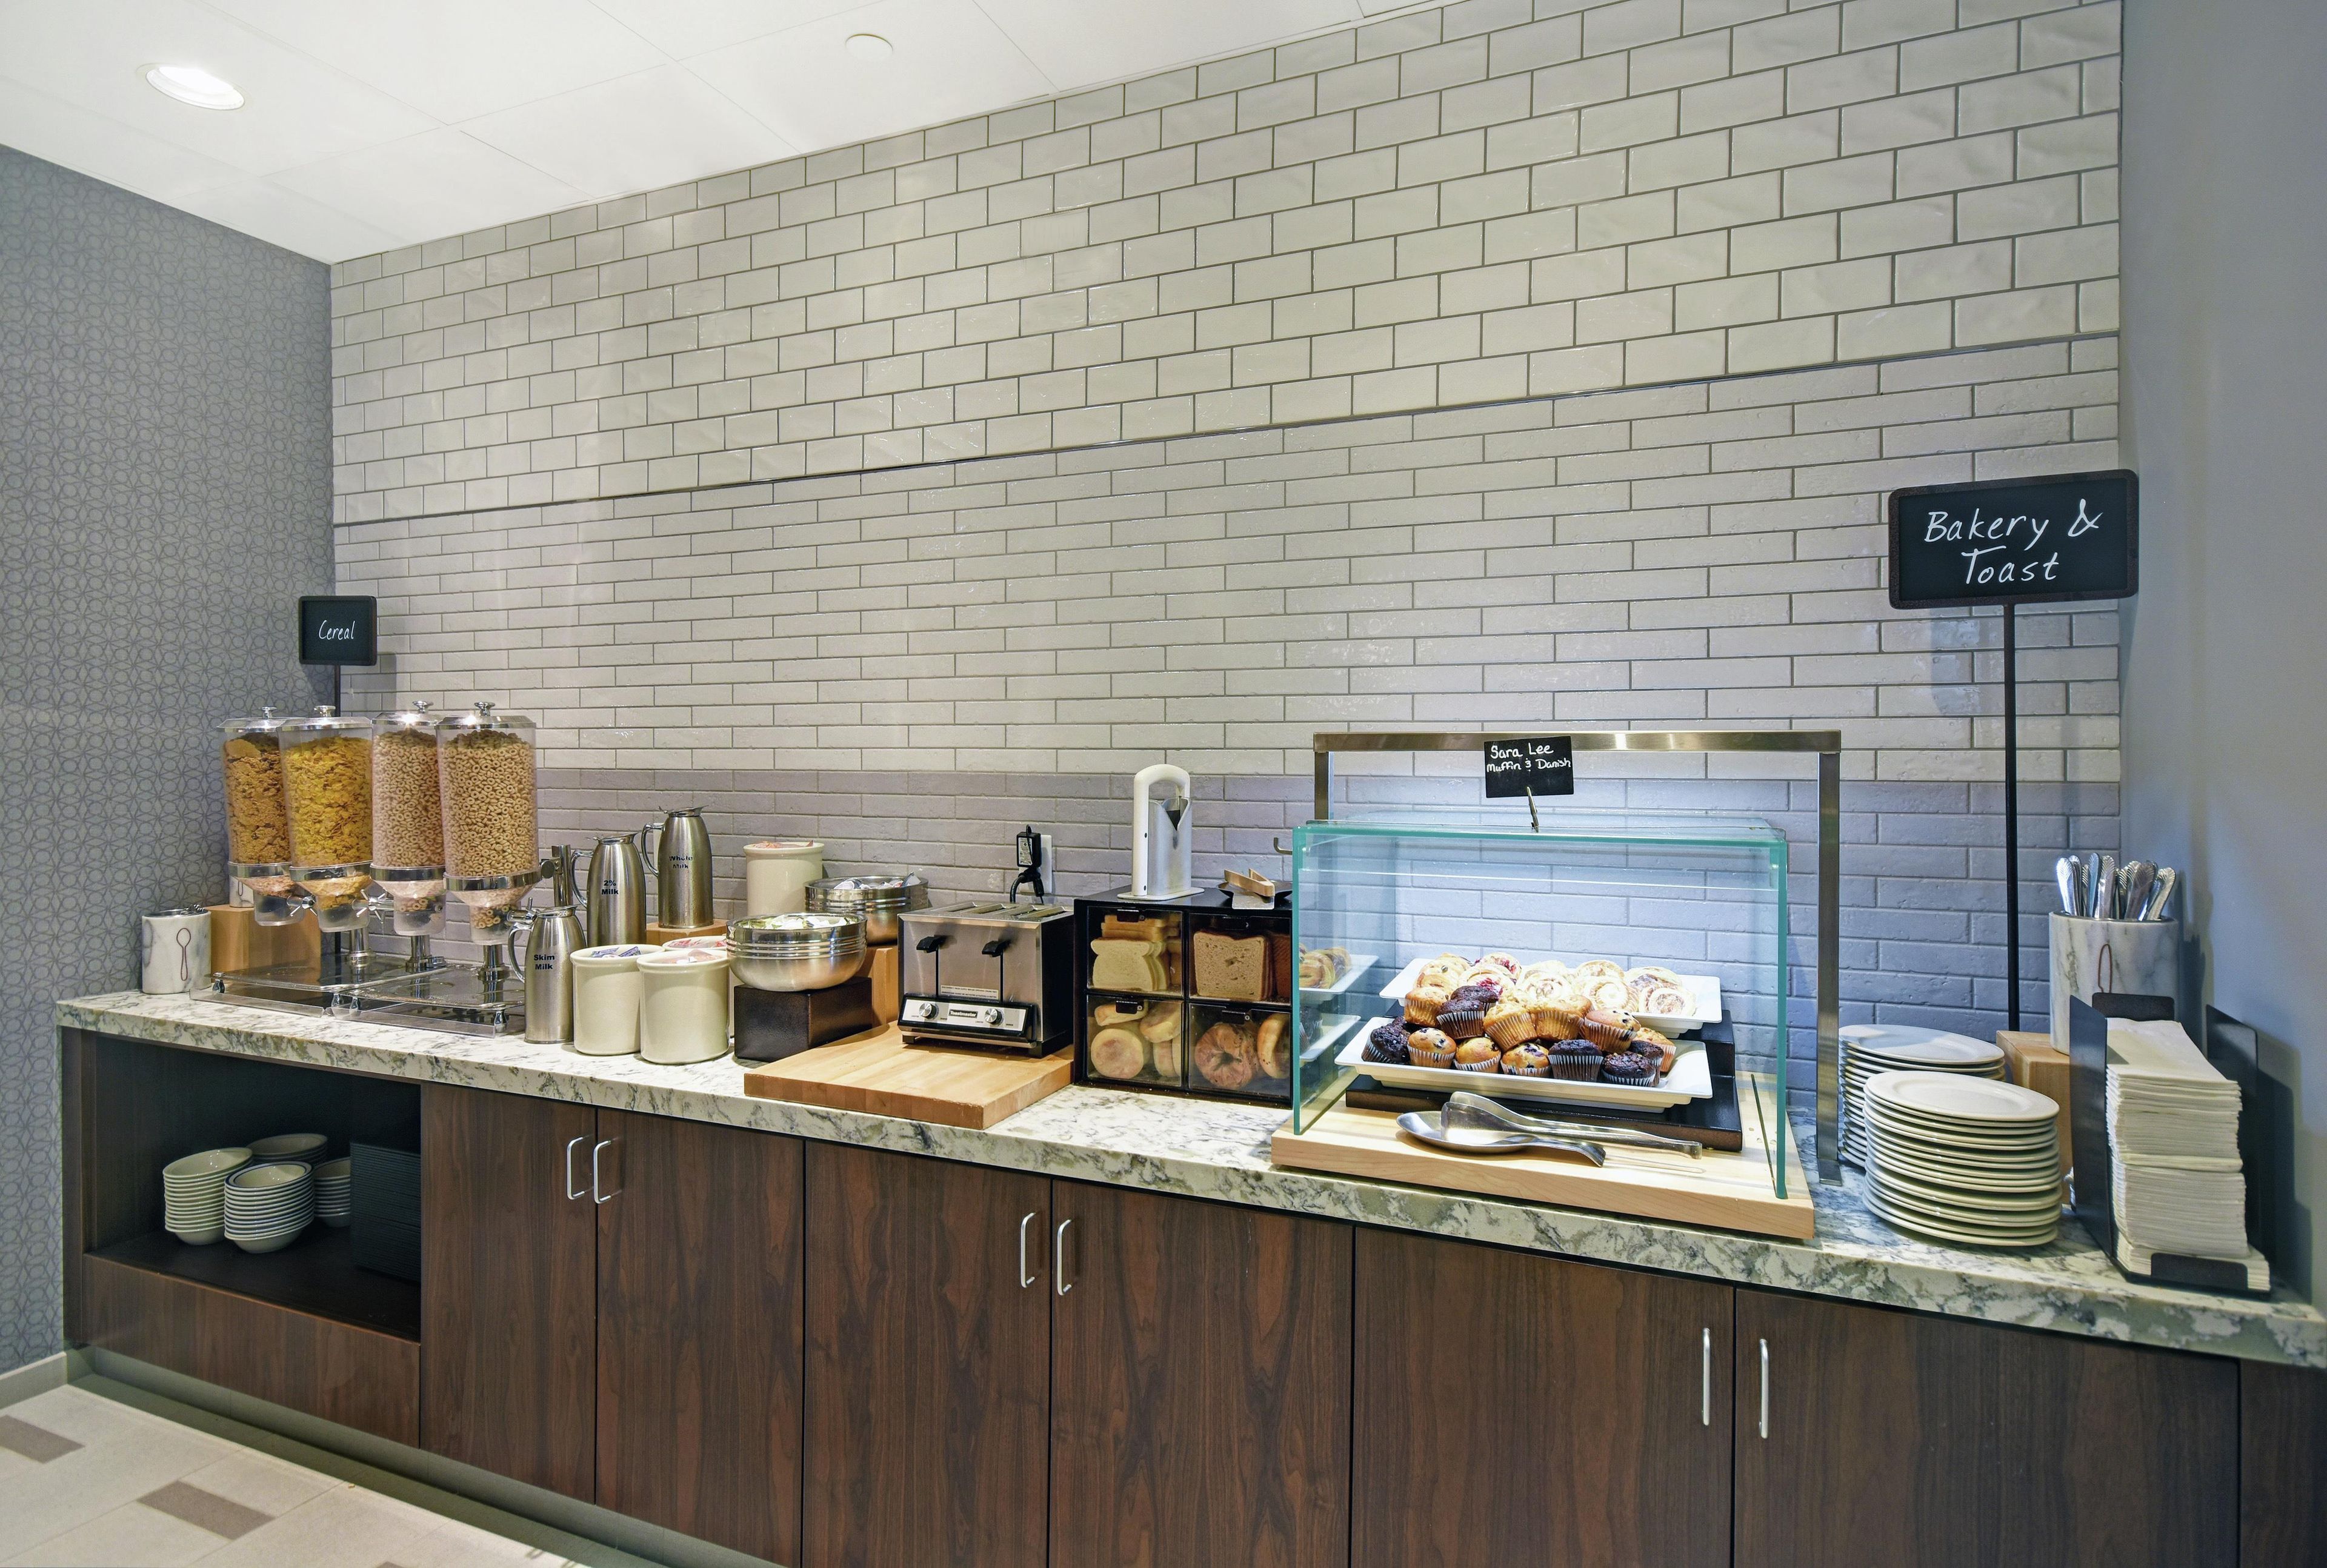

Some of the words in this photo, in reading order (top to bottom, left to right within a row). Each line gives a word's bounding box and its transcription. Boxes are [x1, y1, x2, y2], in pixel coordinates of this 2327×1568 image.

[1924, 508, 2049, 551] Bakery
[2068, 498, 2103, 537] &
[1961, 545, 2060, 584] Toast
[318, 619, 356, 640] Cereal
[1490, 745, 1523, 759] Sara
[1528, 742, 1554, 755] Lee
[1486, 760, 1522, 772] Muffin
[1535, 757, 1571, 769] Danish
